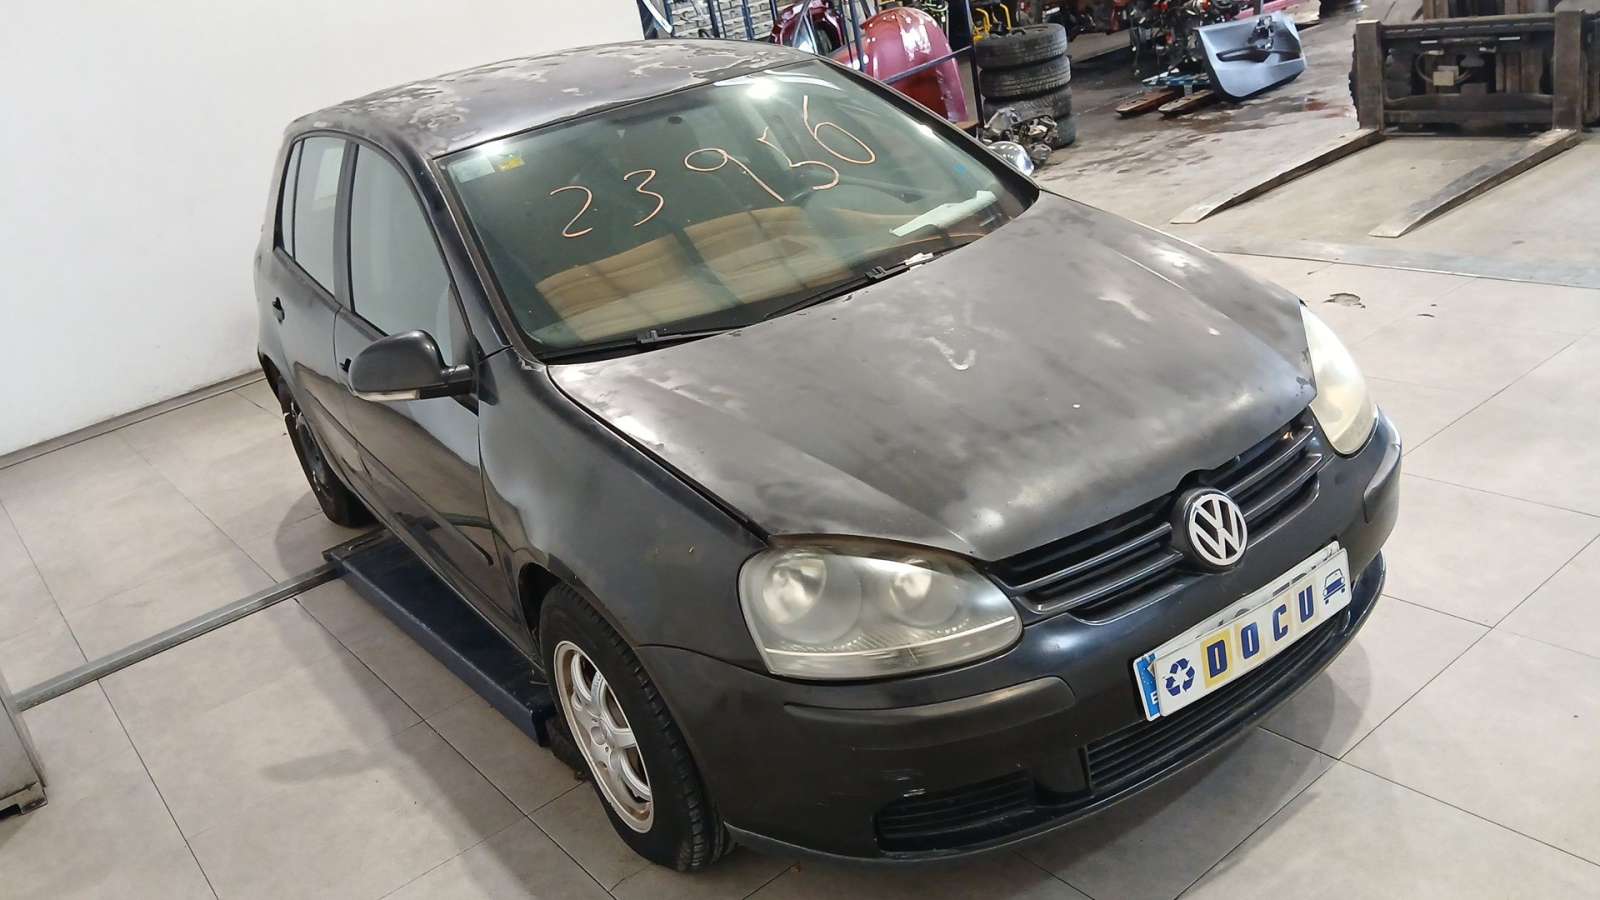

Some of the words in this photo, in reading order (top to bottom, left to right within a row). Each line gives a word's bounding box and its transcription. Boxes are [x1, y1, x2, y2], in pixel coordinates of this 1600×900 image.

[549, 94, 876, 238] 23956
[1189, 493, 1248, 566] VW
[1207, 585, 1315, 678] DOCU
[1150, 691, 1158, 705] E
